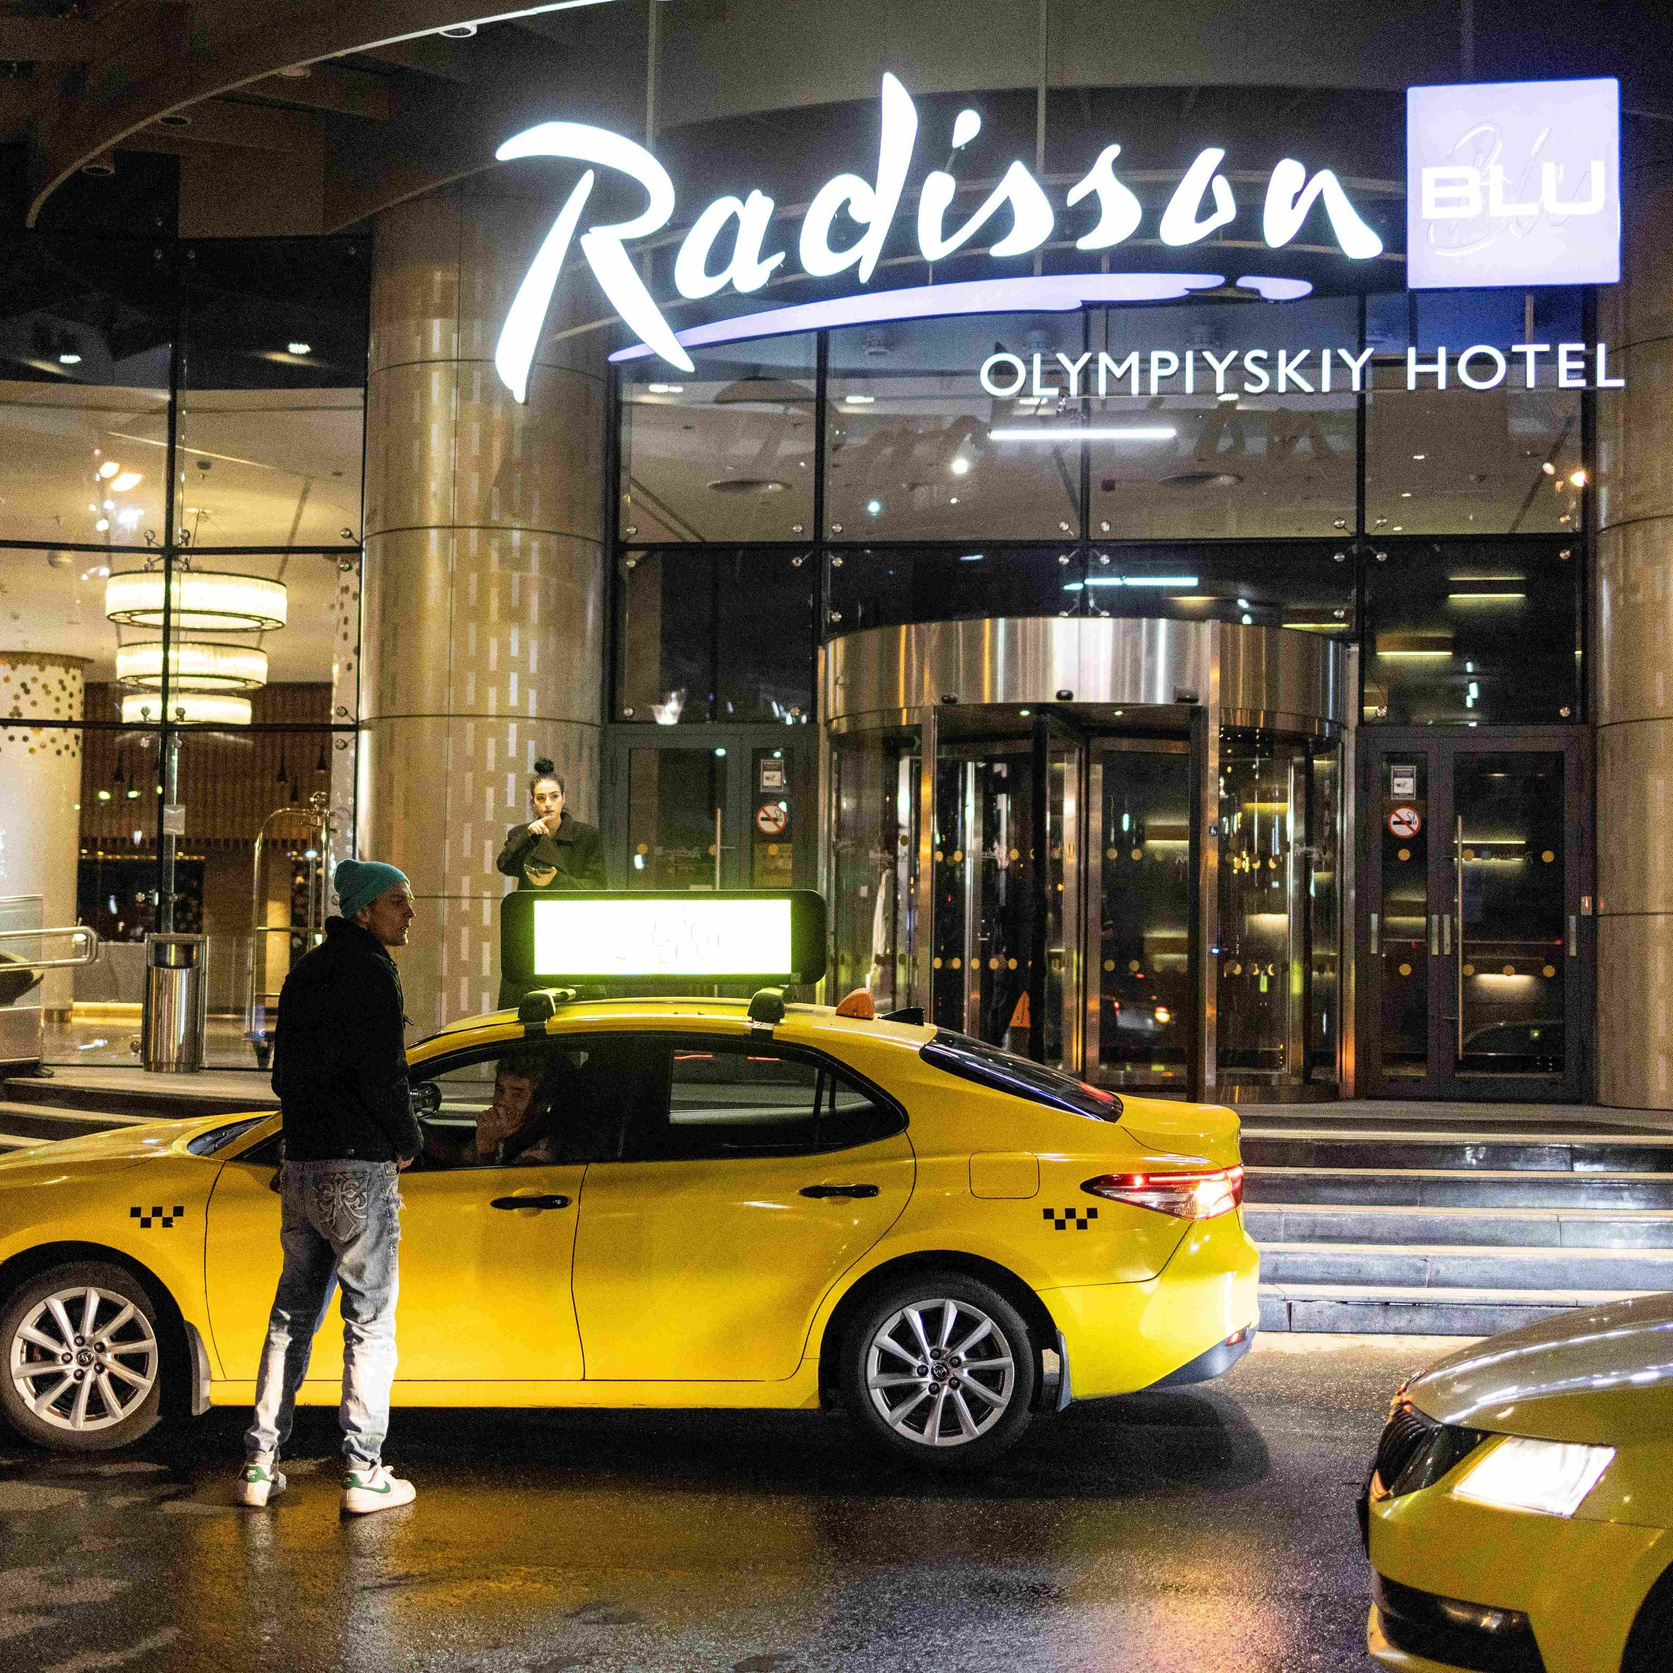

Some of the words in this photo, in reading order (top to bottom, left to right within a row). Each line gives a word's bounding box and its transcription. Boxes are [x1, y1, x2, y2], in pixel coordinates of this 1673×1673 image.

[495, 72, 1383, 403] Radisson
[1421, 160, 1606, 220] BLU
[980, 347, 1375, 397] OLYMPIYSKIY
[1407, 342, 1626, 390] HOTEL
